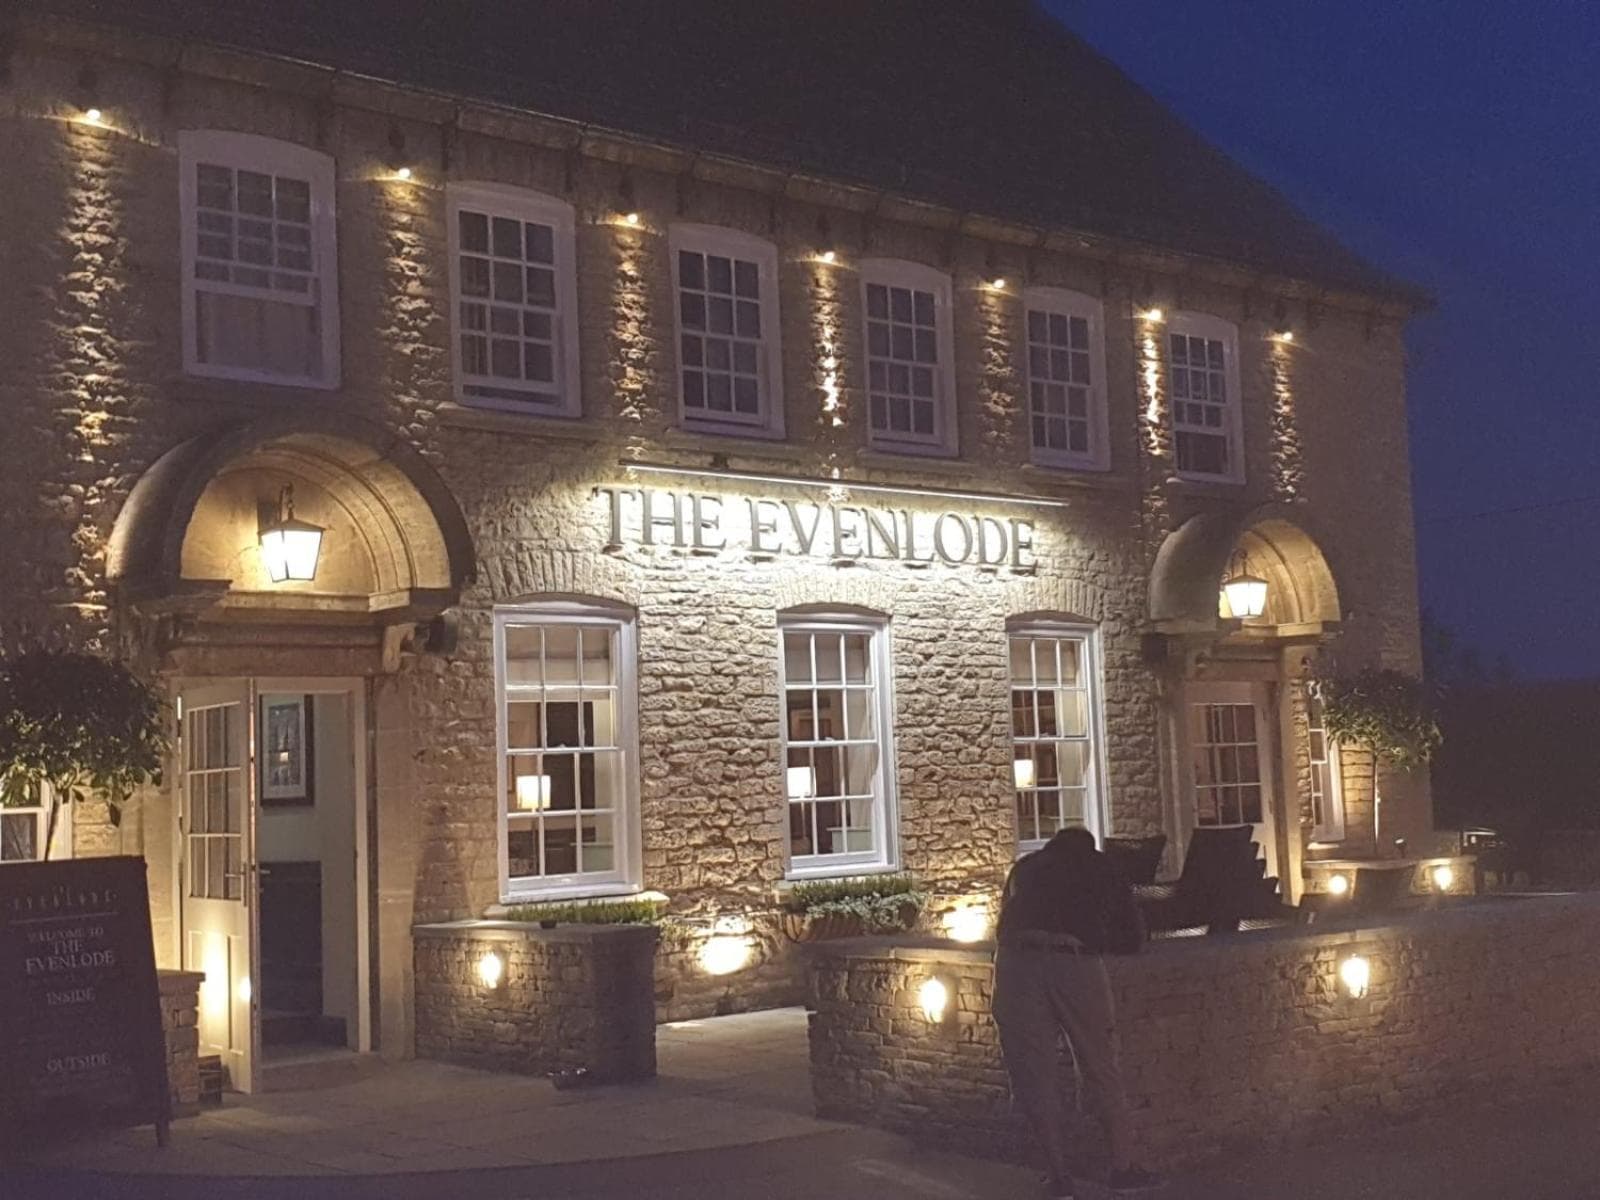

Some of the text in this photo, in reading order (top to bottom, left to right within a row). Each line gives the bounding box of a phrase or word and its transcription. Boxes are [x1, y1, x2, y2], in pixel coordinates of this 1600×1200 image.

[598, 486, 1040, 573] THE EVENLODE
[54, 940, 82, 955] THE
[26, 950, 114, 974] EVENLODE
[46, 987, 95, 1005] INSIDE
[46, 1052, 111, 1073] OUTSIDE
